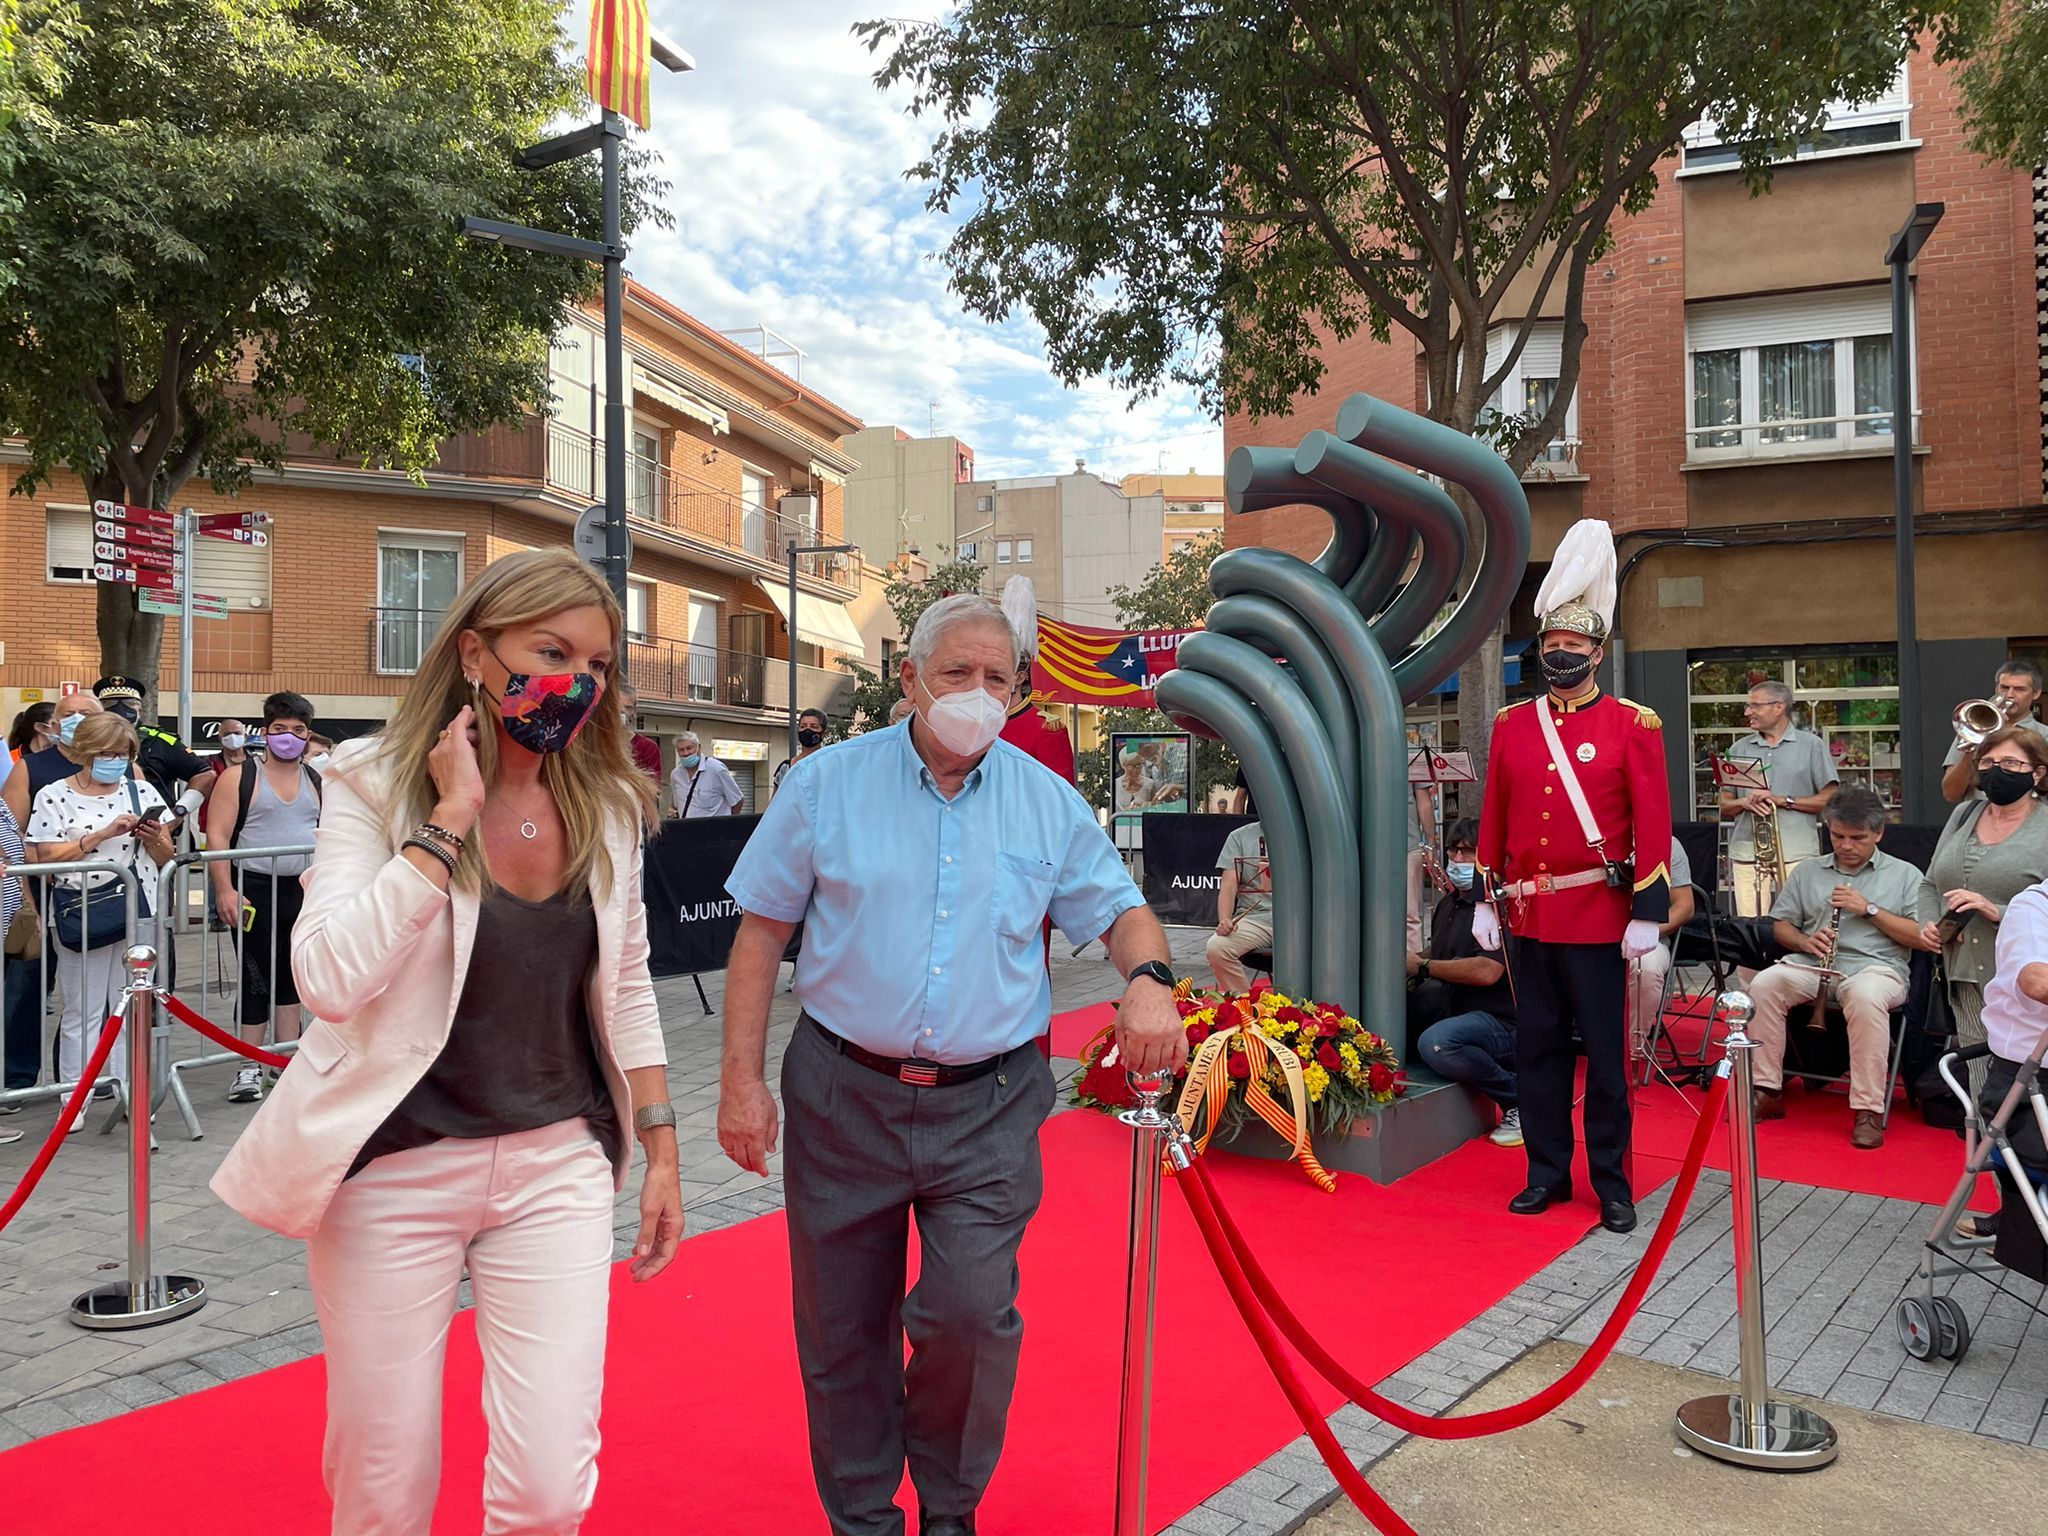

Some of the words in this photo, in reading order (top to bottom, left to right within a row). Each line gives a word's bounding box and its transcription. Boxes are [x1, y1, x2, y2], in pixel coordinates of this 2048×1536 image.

[1139, 634, 1187, 652] LLUI
[680, 900, 744, 922] AJUNTA
[1182, 1037, 1222, 1120] AJUNTAMENT
